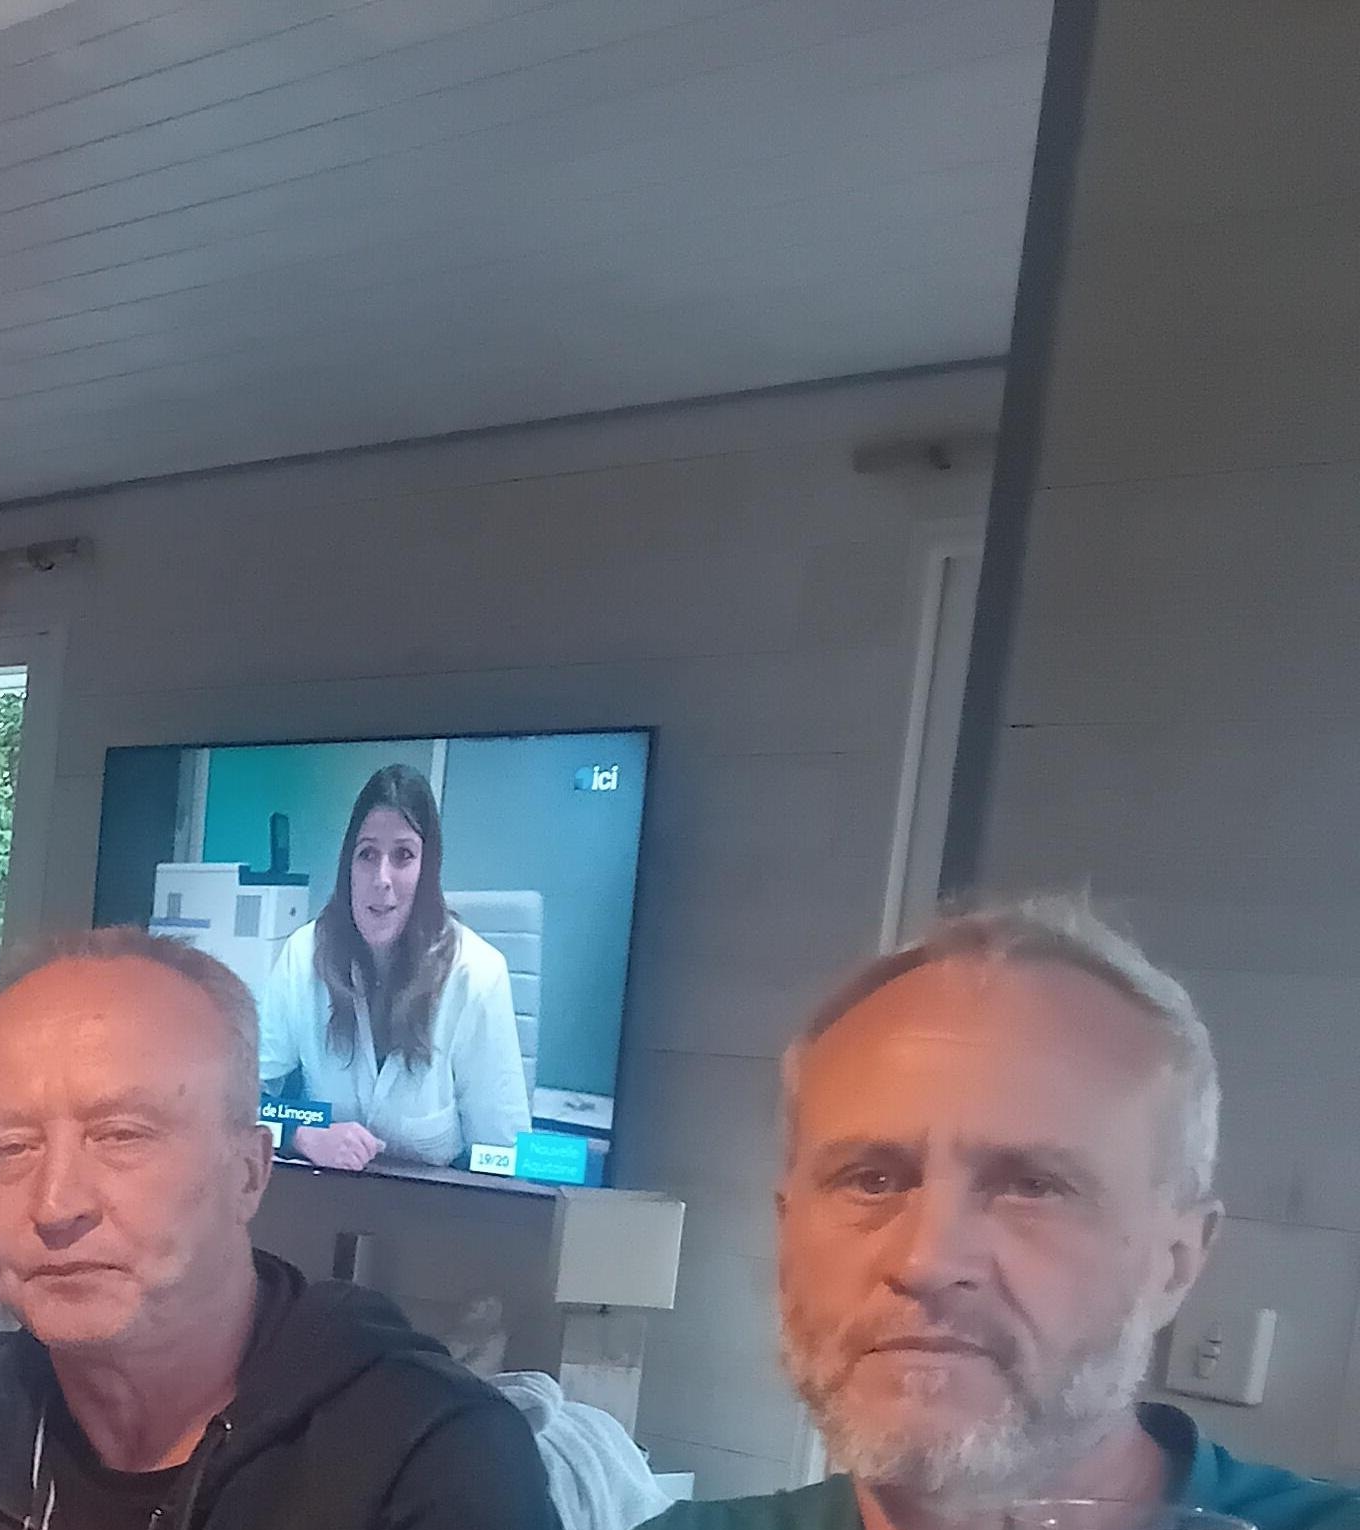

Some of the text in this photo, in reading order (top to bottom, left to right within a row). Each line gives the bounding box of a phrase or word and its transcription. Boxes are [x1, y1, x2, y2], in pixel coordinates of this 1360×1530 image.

[591, 765, 619, 790] ici
[262, 1102, 324, 1125] de Limoges
[478, 1153, 510, 1167] 19/20
